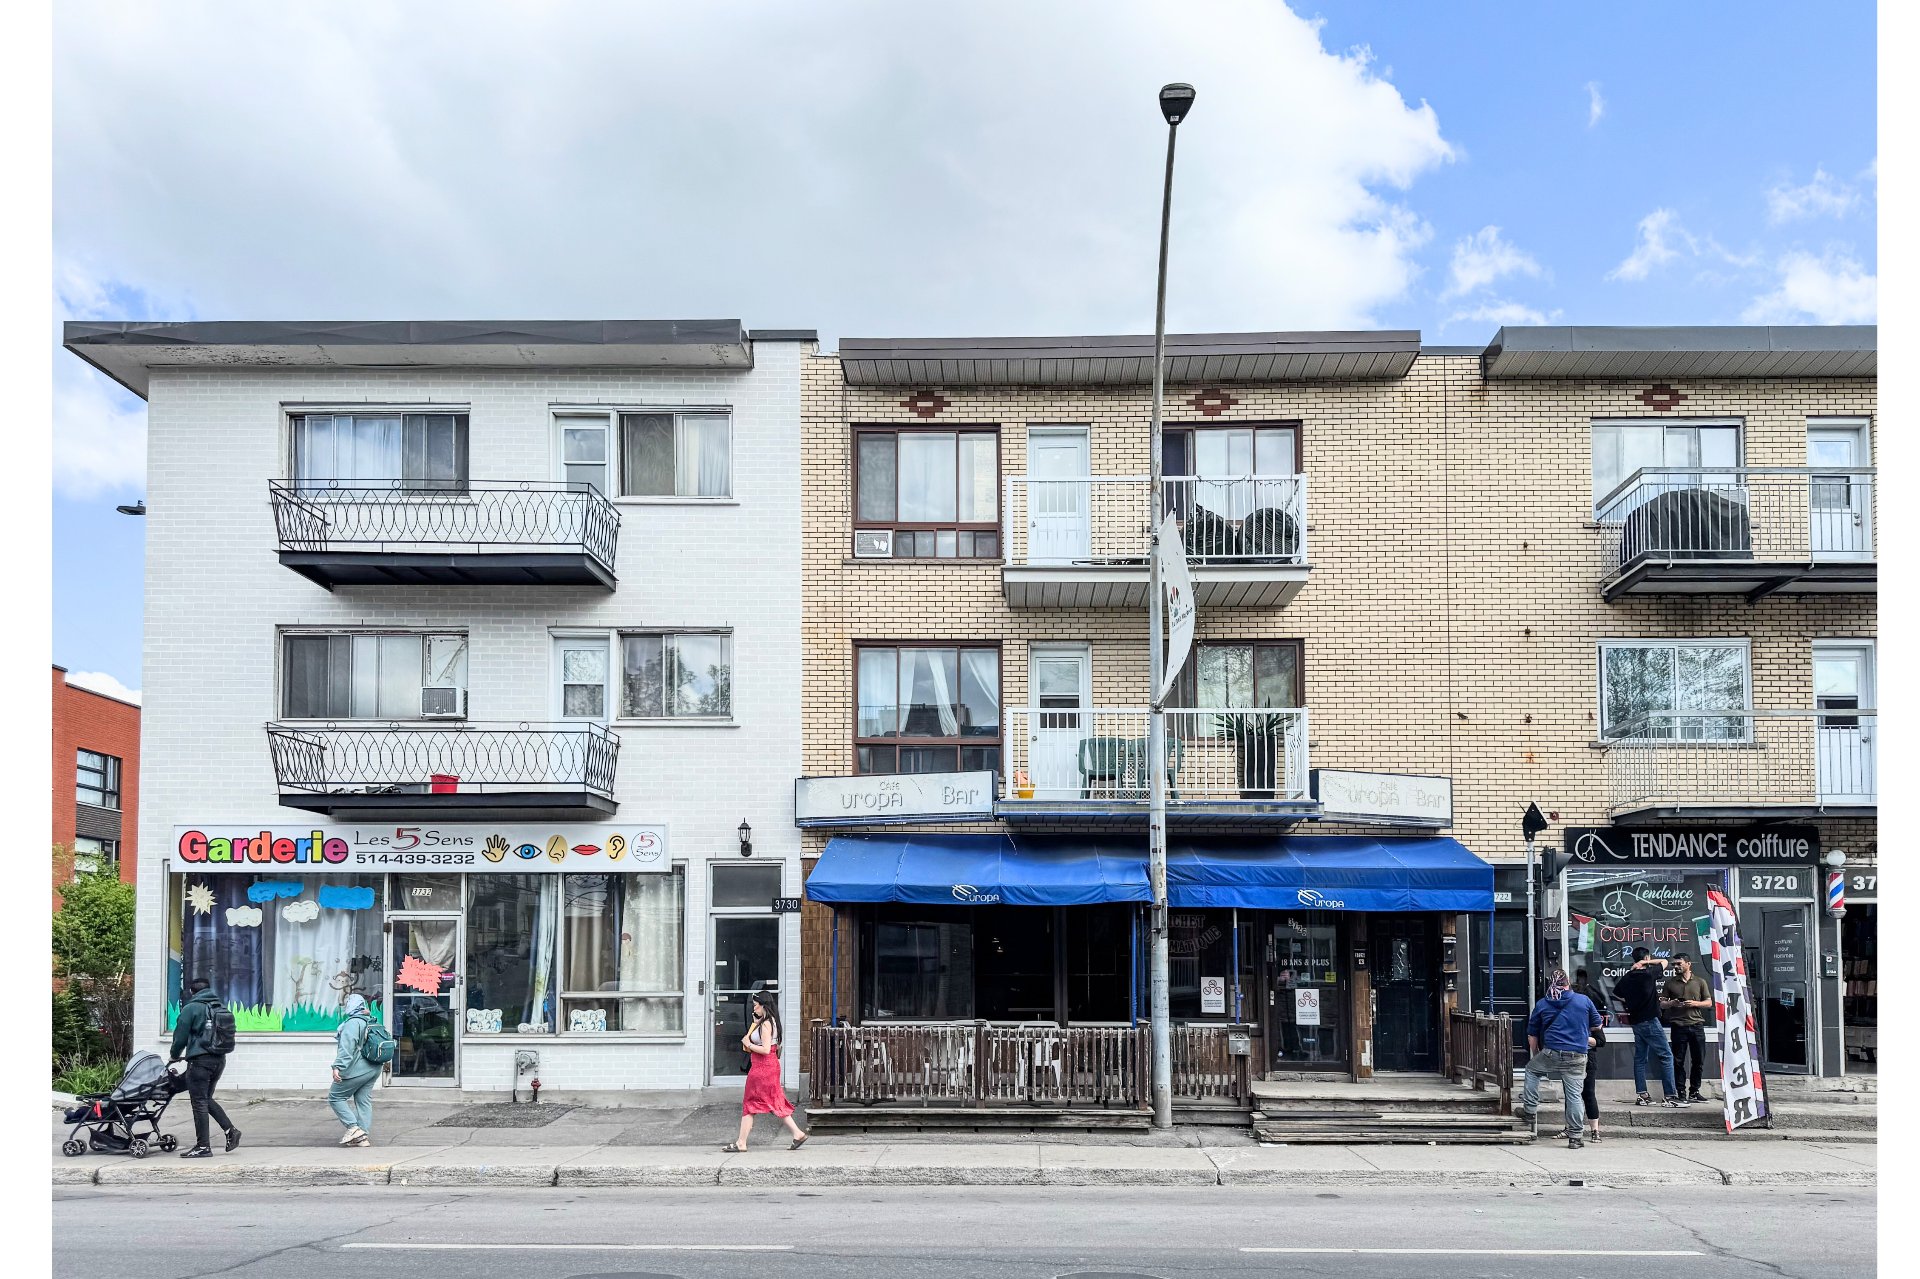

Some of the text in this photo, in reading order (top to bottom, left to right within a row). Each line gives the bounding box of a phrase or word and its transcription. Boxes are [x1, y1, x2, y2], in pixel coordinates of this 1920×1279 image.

[354, 828, 473, 850] Les 5 Sens
[638, 835, 655, 848] 5
[1631, 833, 1809, 858] TENDANCE coiffure
[179, 830, 349, 864] Garderie
[636, 849, 659, 857] Sens
[356, 854, 475, 864] 514-439-3232
[1752, 876, 1798, 890] 3720
[412, 888, 433, 896] 3732
[1495, 893, 1510, 901] 722
[1631, 881, 1694, 901] Tendance
[774, 900, 798, 910] 3730
[1168, 915, 1205, 928] ICHET
[1600, 927, 1690, 942] COIFFURE
[1281, 958, 1288, 966] 18
[1311, 958, 1330, 966] PLUS
[1602, 967, 1632, 978] Coiff
